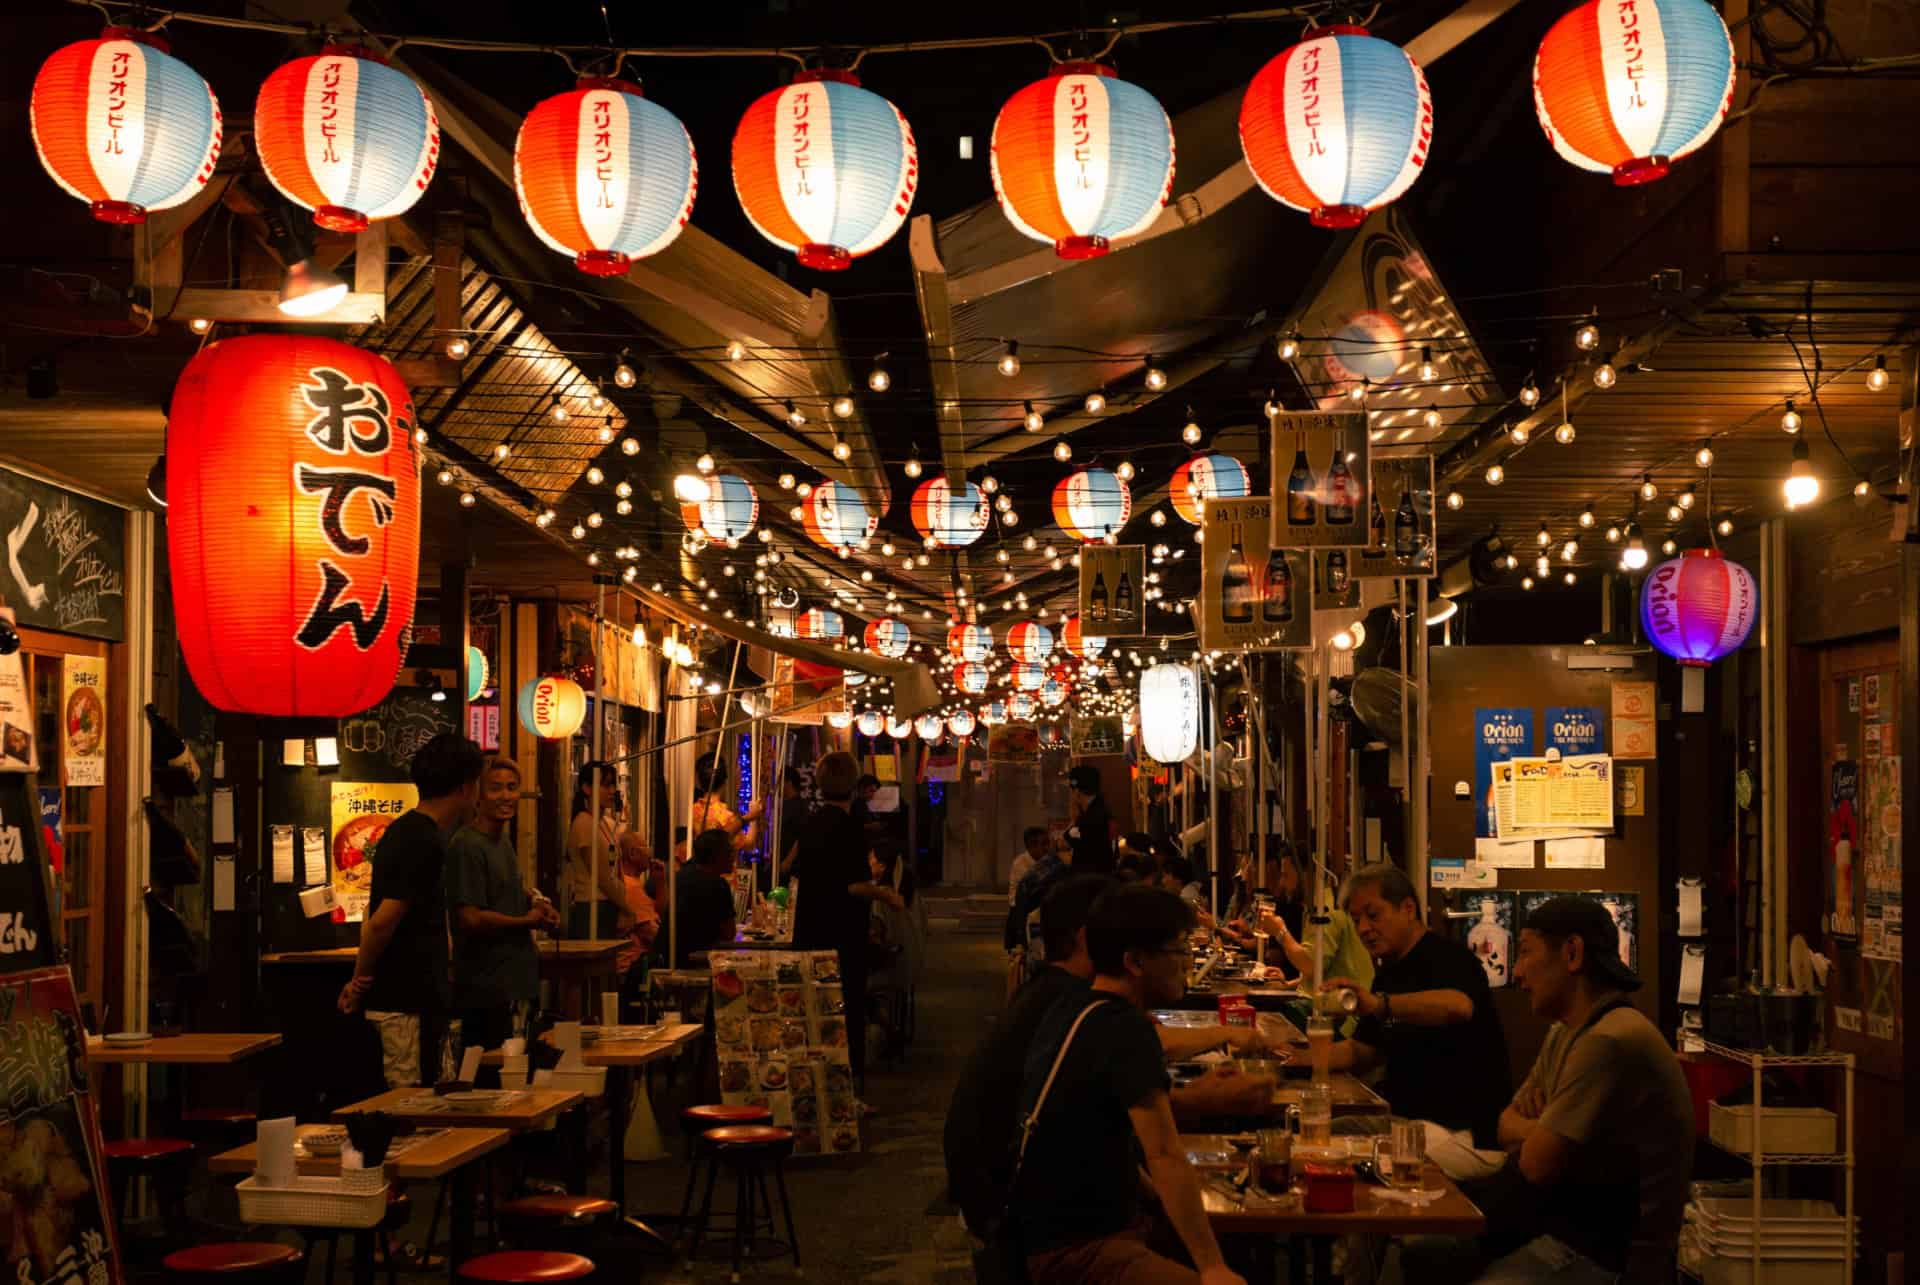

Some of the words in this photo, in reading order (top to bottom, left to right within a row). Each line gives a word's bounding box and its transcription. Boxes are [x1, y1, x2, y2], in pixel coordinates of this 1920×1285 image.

[103, 52, 132, 155] オリオンビール
[319, 63, 343, 164] オリオンビール
[792, 92, 813, 196] オリオンビール
[1069, 83, 1091, 190] オリオンビール
[1300, 46, 1327, 157] オリオンビール
[592, 100, 615, 209] オリオンビール
[294, 367, 397, 650] おでん
[1651, 567, 1676, 633] Orion
[536, 684, 555, 724] Orion
[1483, 721, 1524, 737] Orion
[1553, 720, 1595, 737] Orion
[348, 799, 404, 814] 沖縄そば
